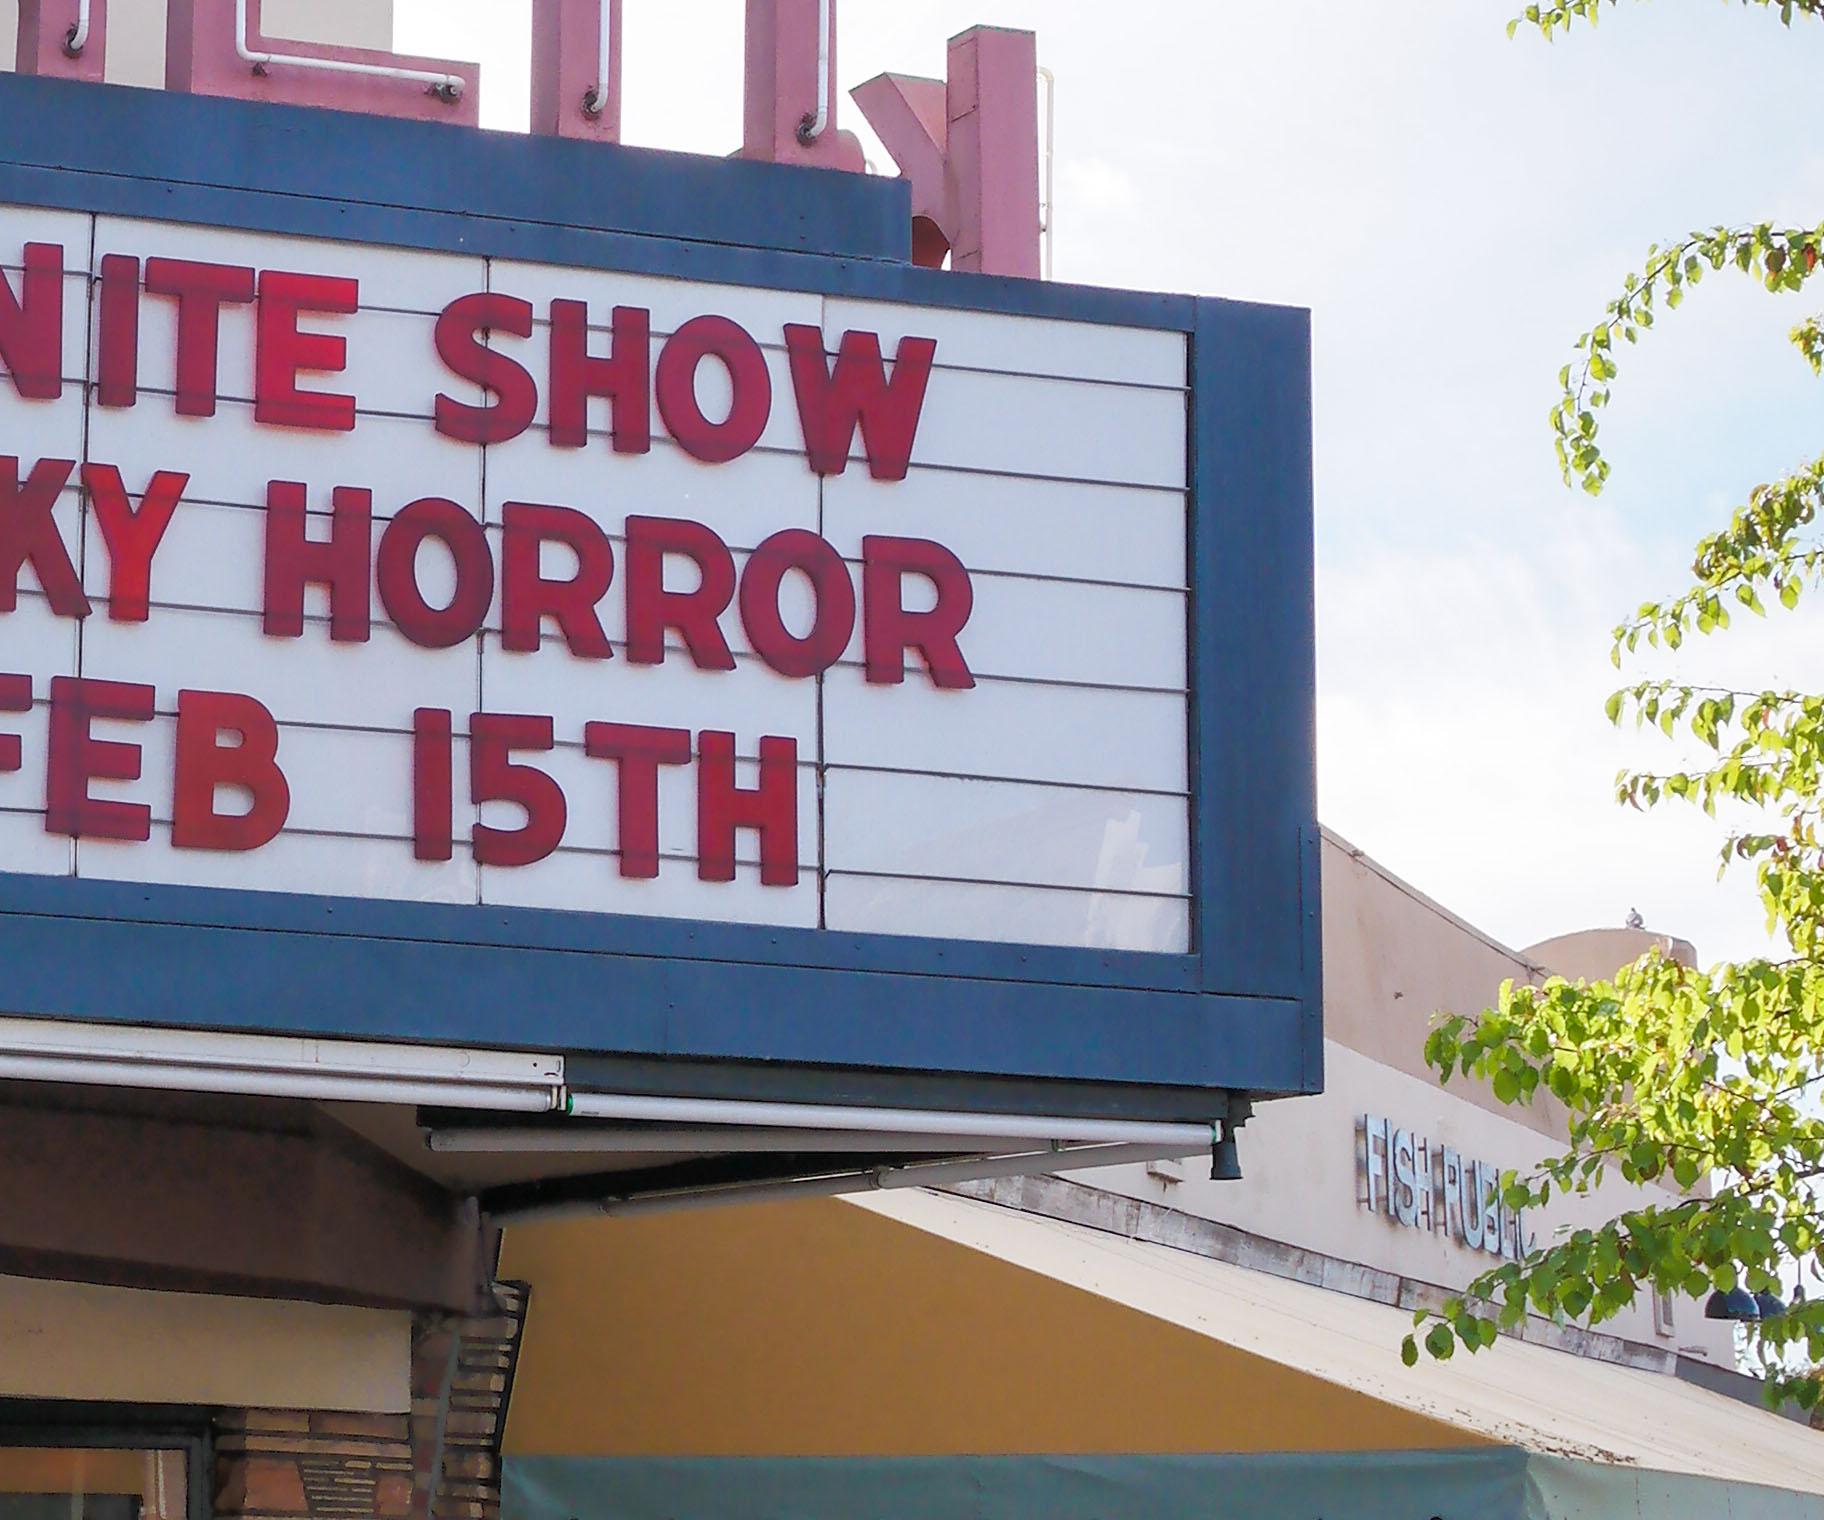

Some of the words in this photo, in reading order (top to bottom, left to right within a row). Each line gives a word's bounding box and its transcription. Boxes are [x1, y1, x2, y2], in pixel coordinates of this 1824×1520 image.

[434, 294, 938, 481] SHOW
[262, 480, 976, 688] HORROR
[412, 706, 799, 886] 15TH
[1364, 1113, 1436, 1231] FISH
